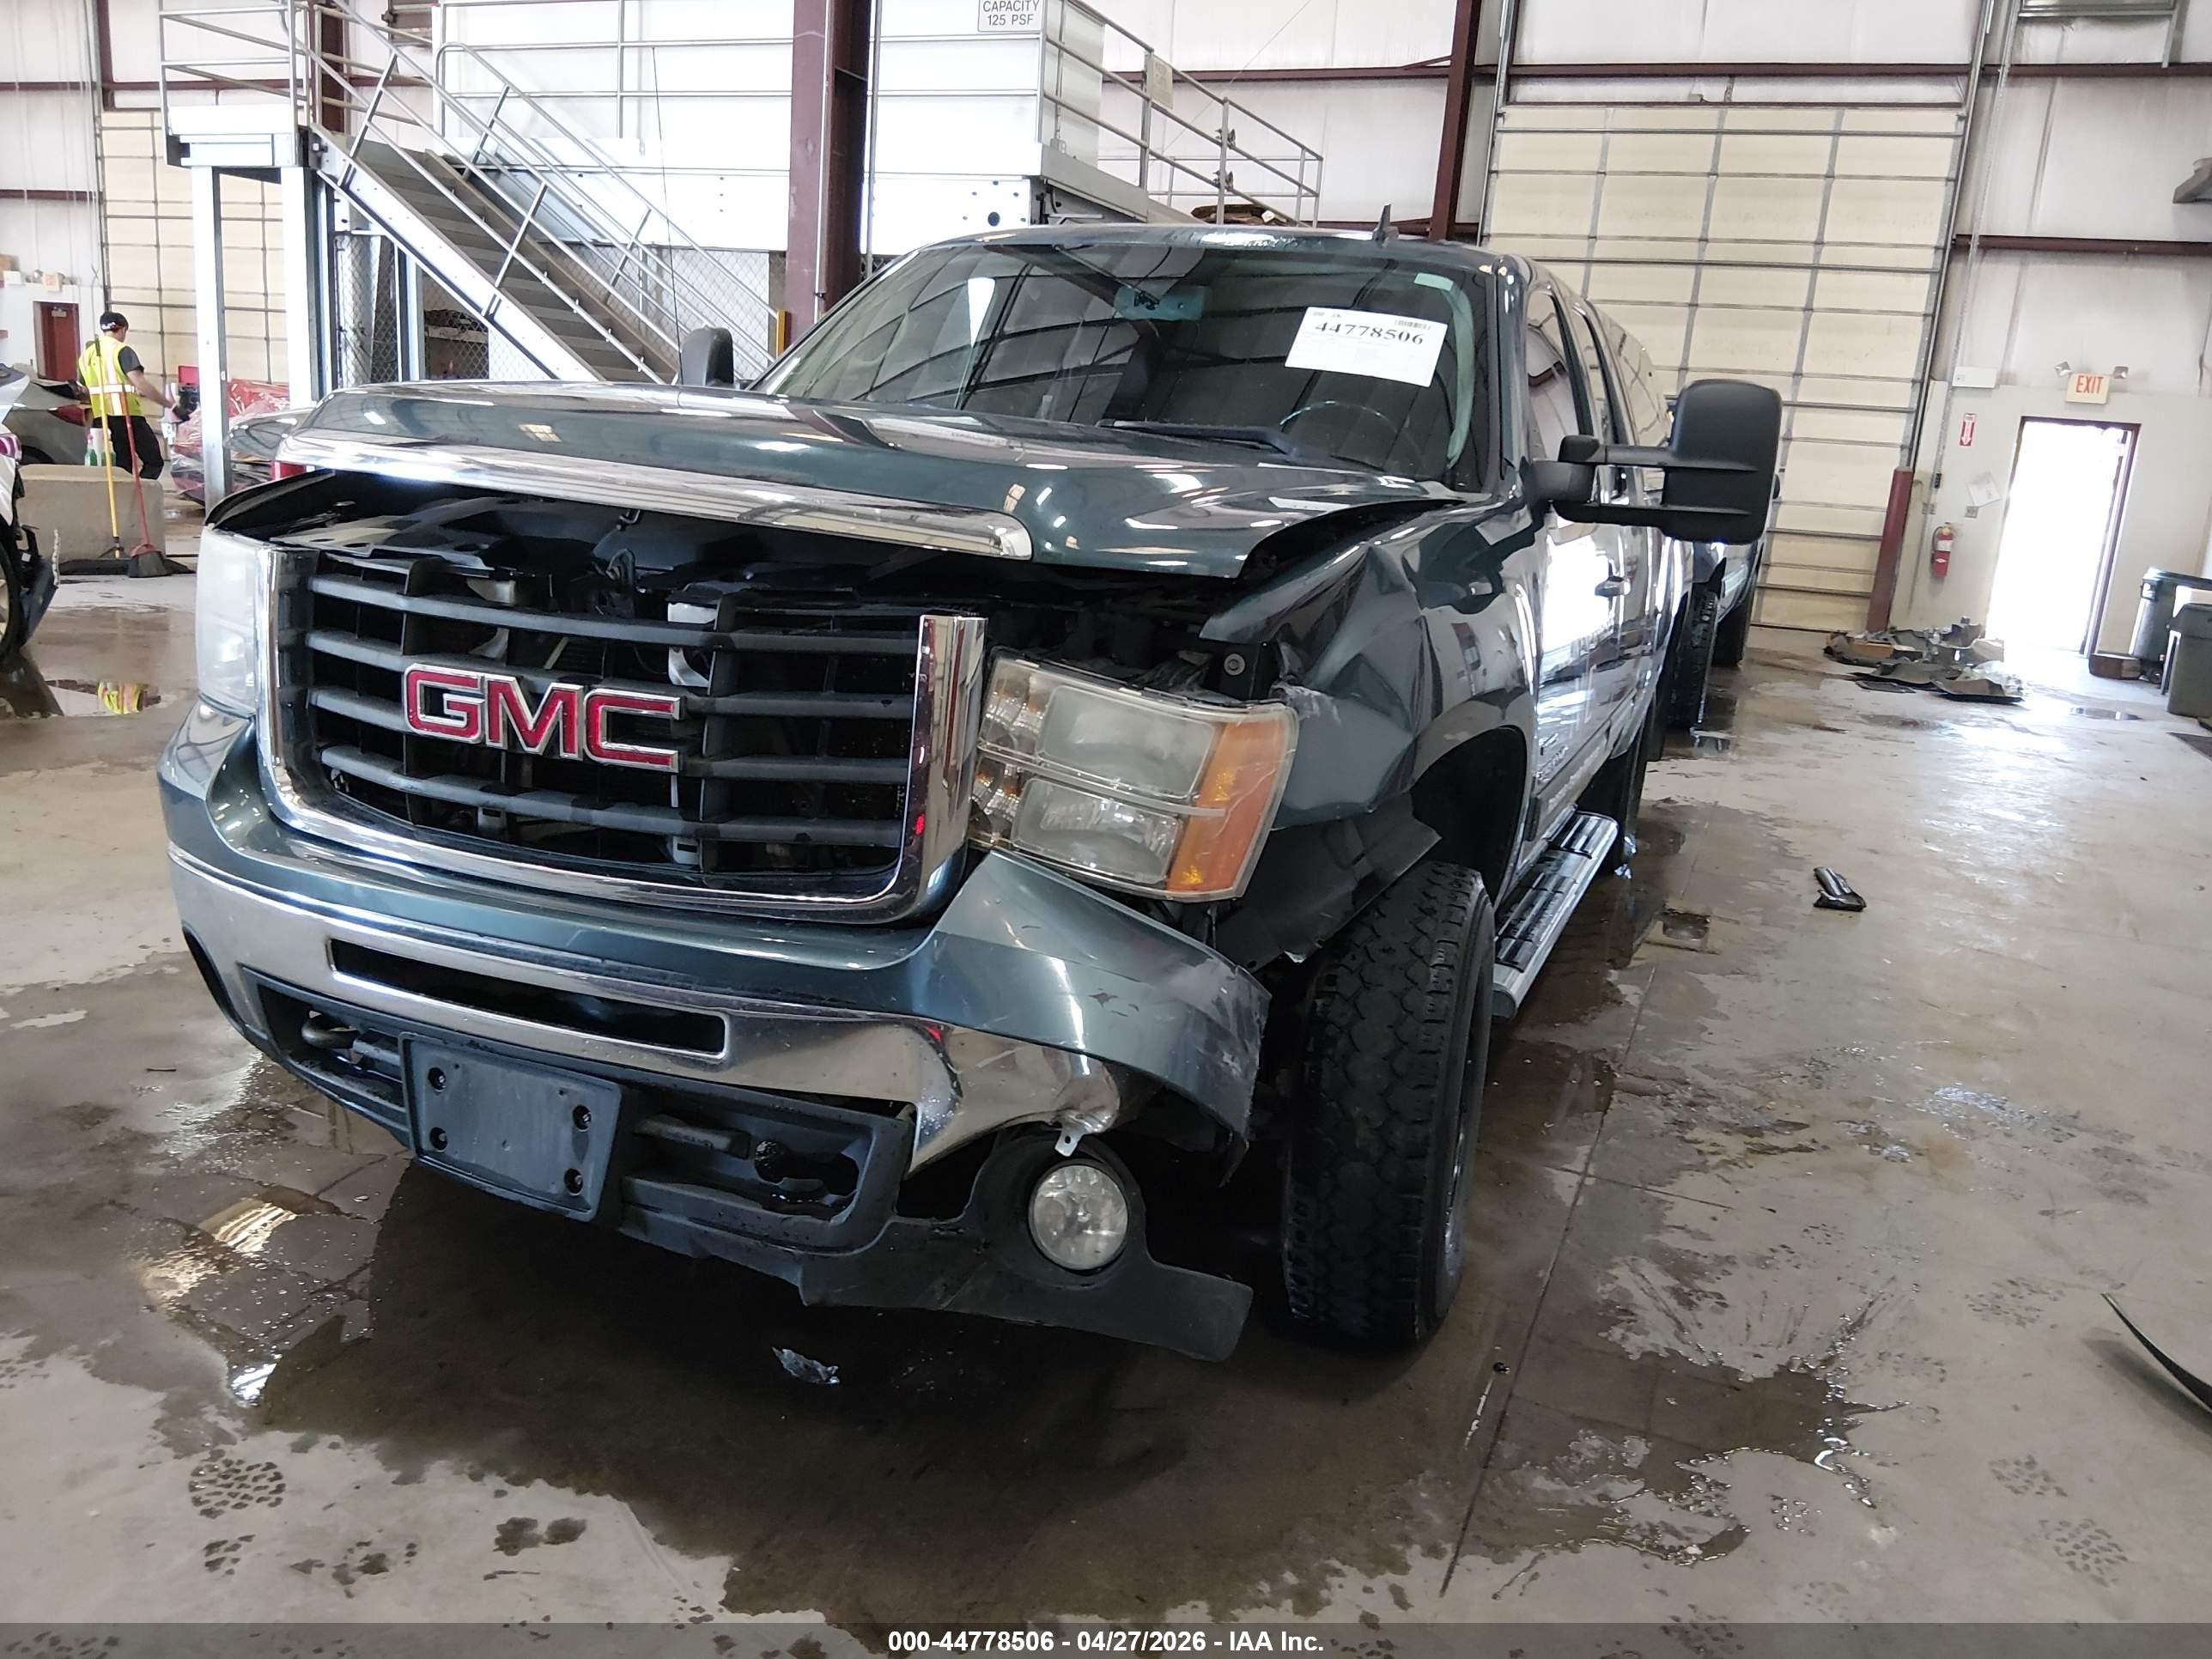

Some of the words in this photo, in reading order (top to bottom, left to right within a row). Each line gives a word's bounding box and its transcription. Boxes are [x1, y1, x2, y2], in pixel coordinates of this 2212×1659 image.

[982, 0, 1040, 12] CAPACITY
[988, 14, 1006, 26] 125
[1012, 14, 1034, 26] PSF
[1315, 321, 1424, 345] 44778506
[2075, 374, 2104, 394] EXIT
[404, 663, 681, 773] GMC
